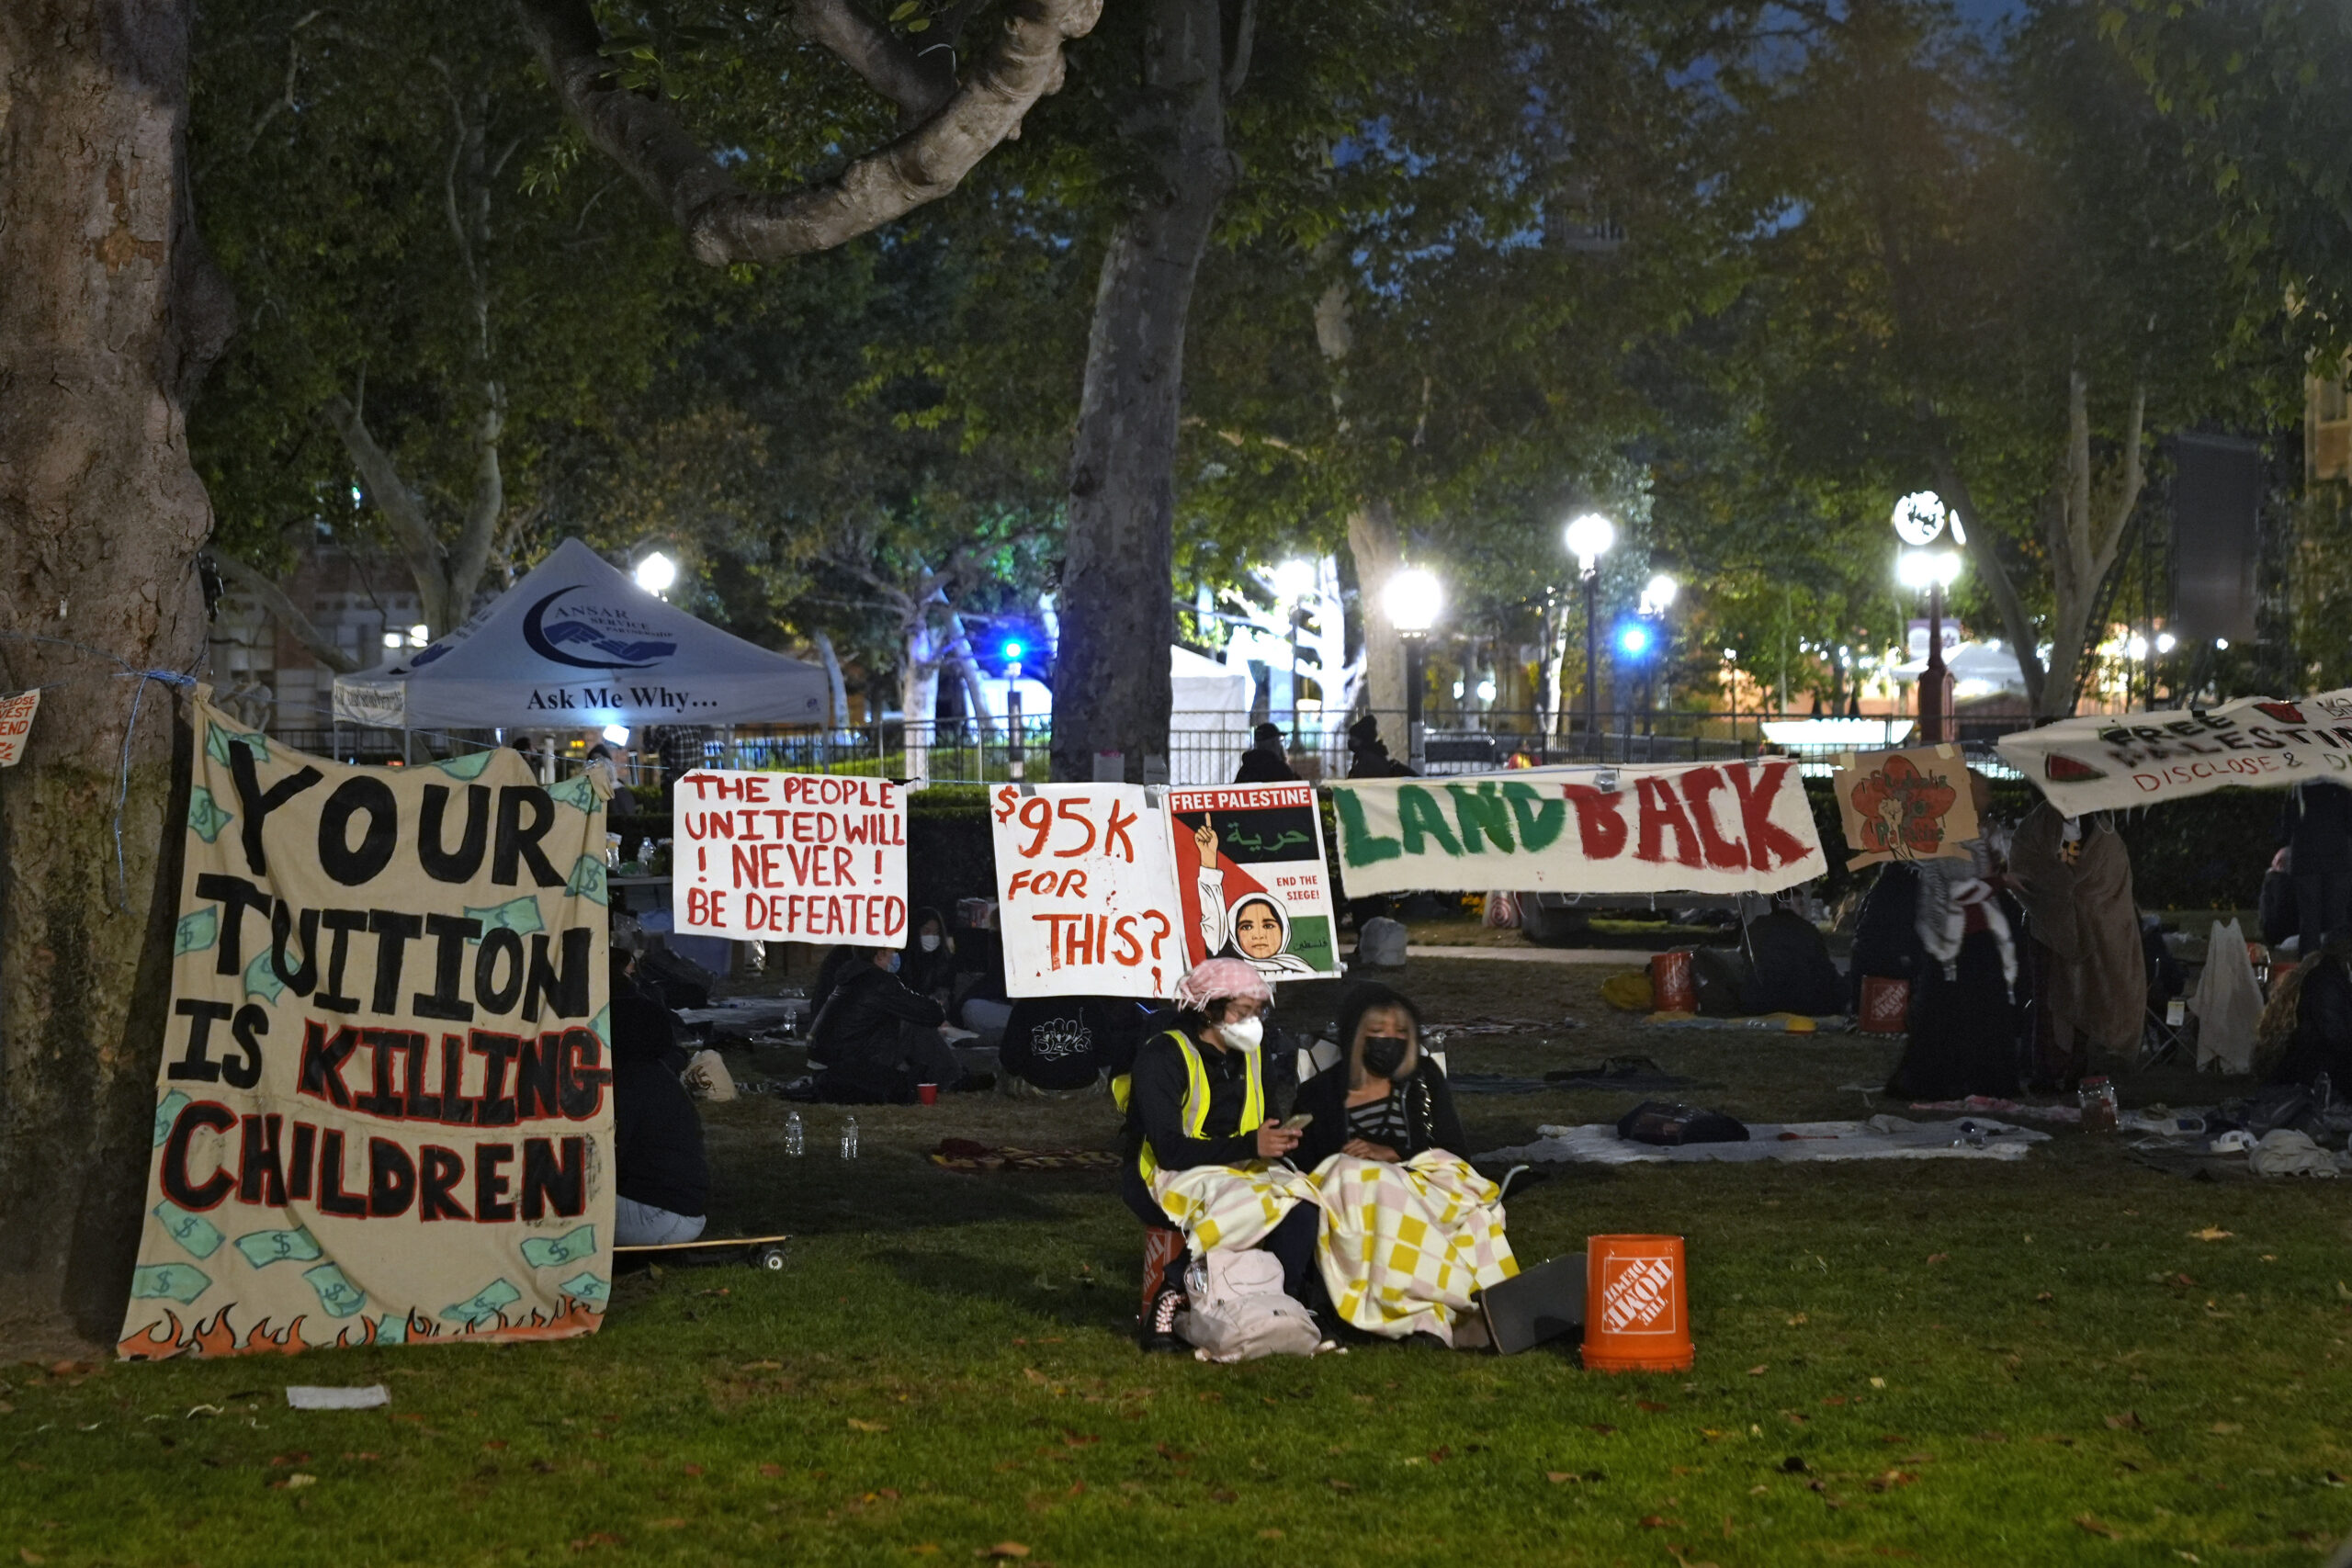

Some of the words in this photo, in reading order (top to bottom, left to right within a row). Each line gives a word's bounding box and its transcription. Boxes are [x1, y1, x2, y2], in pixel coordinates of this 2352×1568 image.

[554, 605, 628, 619] ANSAR
[591, 617, 649, 630] SERVICE
[527, 688, 576, 709] Ask
[583, 688, 623, 708] Me
[2097, 716, 2236, 747] FREE
[684, 773, 770, 803] THE
[784, 776, 896, 809] PEOPLE
[2132, 755, 2280, 793] DISCLOSE
[229, 739, 567, 887] YOUR
[1170, 793, 1215, 812] FREE
[1217, 788, 1310, 808] PALESTINE
[1335, 781, 1566, 868] LAND
[1562, 761, 1815, 874] BACK
[685, 809, 837, 843] UNITED
[843, 813, 905, 846] WILL
[1227, 821, 1309, 852] حرية
[732, 843, 856, 889] NEVER
[1008, 868, 1088, 900] FOR
[1276, 876, 1296, 886] END
[1299, 874, 1317, 886] THE
[687, 887, 727, 928] BE
[745, 892, 906, 936] DEFEATED
[1286, 890, 1319, 901] SIEGE!
[196, 873, 592, 1023] TUITION
[1032, 909, 1171, 995] THIS?
[167, 998, 269, 1089] IS
[298, 1017, 612, 1128] KILLING
[160, 1100, 585, 1224] CHILDREN
[1603, 1258, 1673, 1332] HOME
[1604, 1258, 1647, 1305] DEPOT
